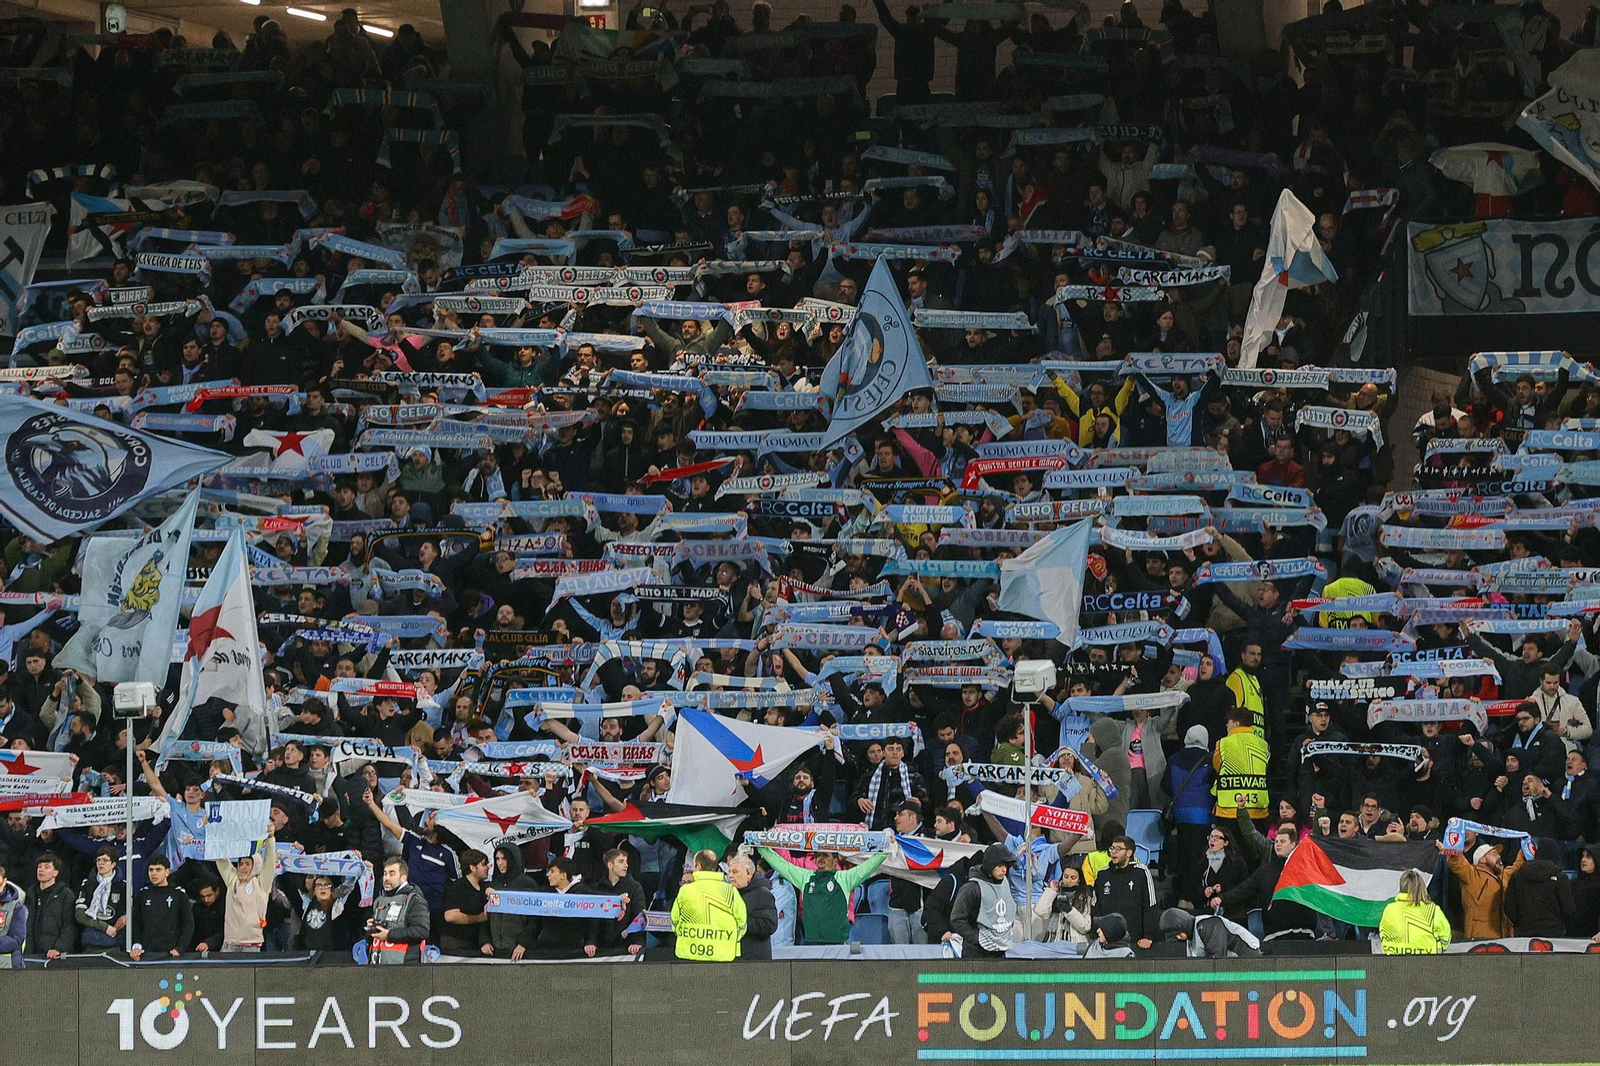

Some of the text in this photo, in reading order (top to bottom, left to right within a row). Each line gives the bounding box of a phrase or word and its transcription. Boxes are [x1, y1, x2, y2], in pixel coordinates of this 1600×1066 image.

[135, 254, 172, 268] LIVEIRA
[183, 258, 202, 270] TEIS
[454, 262, 523, 276] RC CELTA
[576, 266, 615, 280] CELES
[470, 276, 496, 289] VIDA
[119, 290, 148, 303] BIRRA
[480, 299, 522, 311] CELEST
[291, 306, 329, 324] IAGO
[684, 354, 707, 365] IAGO
[1132, 352, 1206, 371] CELTA
[627, 371, 695, 389] RC CELTA
[1223, 371, 1329, 384] OVIDA CELESTE
[542, 386, 588, 395] CELTA
[370, 405, 437, 420] RO CELTA
[1305, 410, 1376, 428] VIDA CEL
[320, 455, 388, 470] CLUB CELT
[1006, 460, 1031, 470] VENTO
[1194, 474, 1236, 485] ASPAS
[1013, 504, 1052, 518] EURO
[1061, 501, 1102, 515] CELTA
[970, 530, 1034, 543] CELTA
[692, 543, 751, 557] CELTA
[1545, 577, 1570, 588] VIGO
[634, 588, 677, 599] FEITO NA
[259, 612, 307, 624] CELTA
[485, 633, 549, 644] EAL CLUB CELTA
[805, 633, 867, 647] CELTA
[389, 649, 472, 667] CARCAMANS
[1414, 648, 1464, 662] CELTA
[1448, 661, 1486, 671] CORAZ
[1400, 701, 1461, 717] CELTA
[1484, 702, 1510, 711] ANCHESTER
[199, 743, 234, 754] ASPA
[340, 740, 396, 759] CELTA
[1220, 776, 1267, 789] STEWAR
[1045, 808, 1084, 822] NORTE
[1038, 815, 1087, 832] CELESTE
[757, 831, 865, 847] EURO CELTA
[279, 855, 366, 875] CELTA
[676, 923, 735, 942] SECURITY
[688, 942, 716, 958] 098
[1383, 945, 1434, 955] ECURITY
[742, 992, 899, 1041] UEFA
[916, 990, 1366, 1041] FOUNDATION
[201, 996, 462, 1050] YEARS
